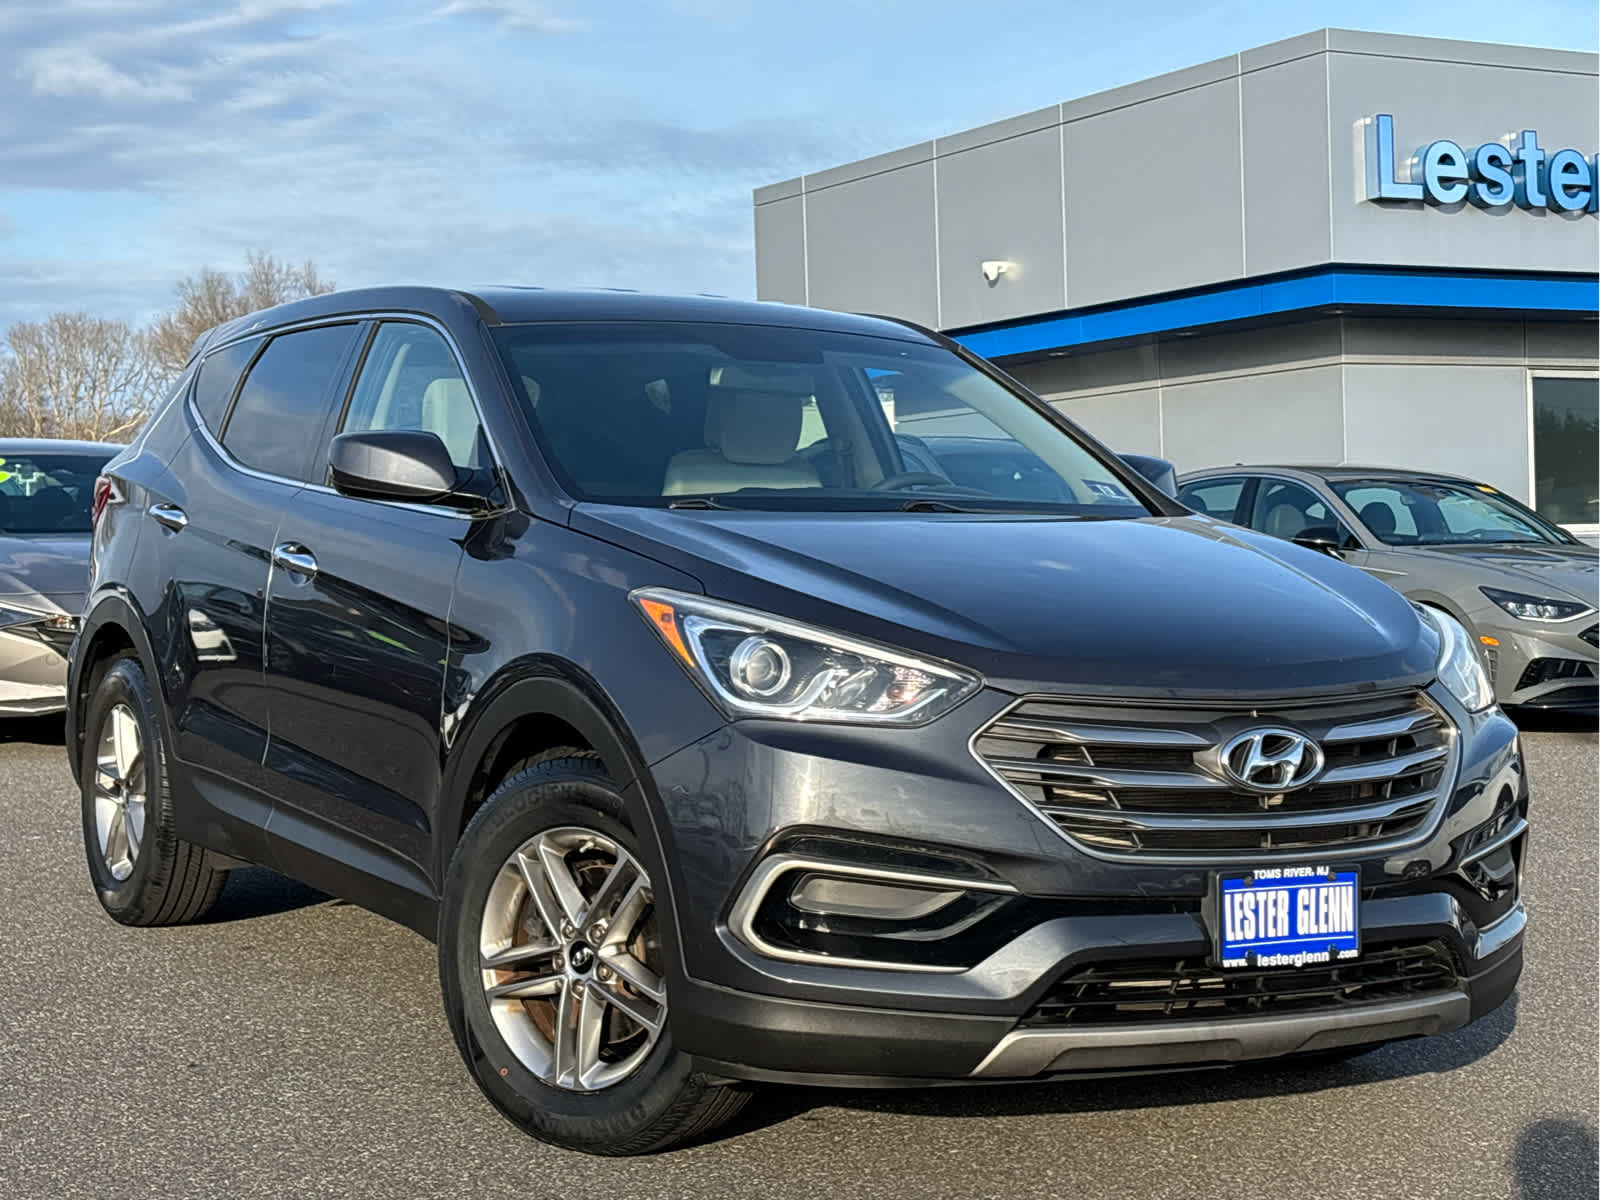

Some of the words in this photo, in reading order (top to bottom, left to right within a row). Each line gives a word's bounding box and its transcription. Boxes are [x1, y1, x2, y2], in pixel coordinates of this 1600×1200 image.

[1367, 114, 1599, 211] Leste
[1253, 869, 1281, 879] TOMS
[1317, 866, 1329, 876] NJ
[1224, 890, 1289, 941] LESTER
[1297, 886, 1353, 935] GLENN
